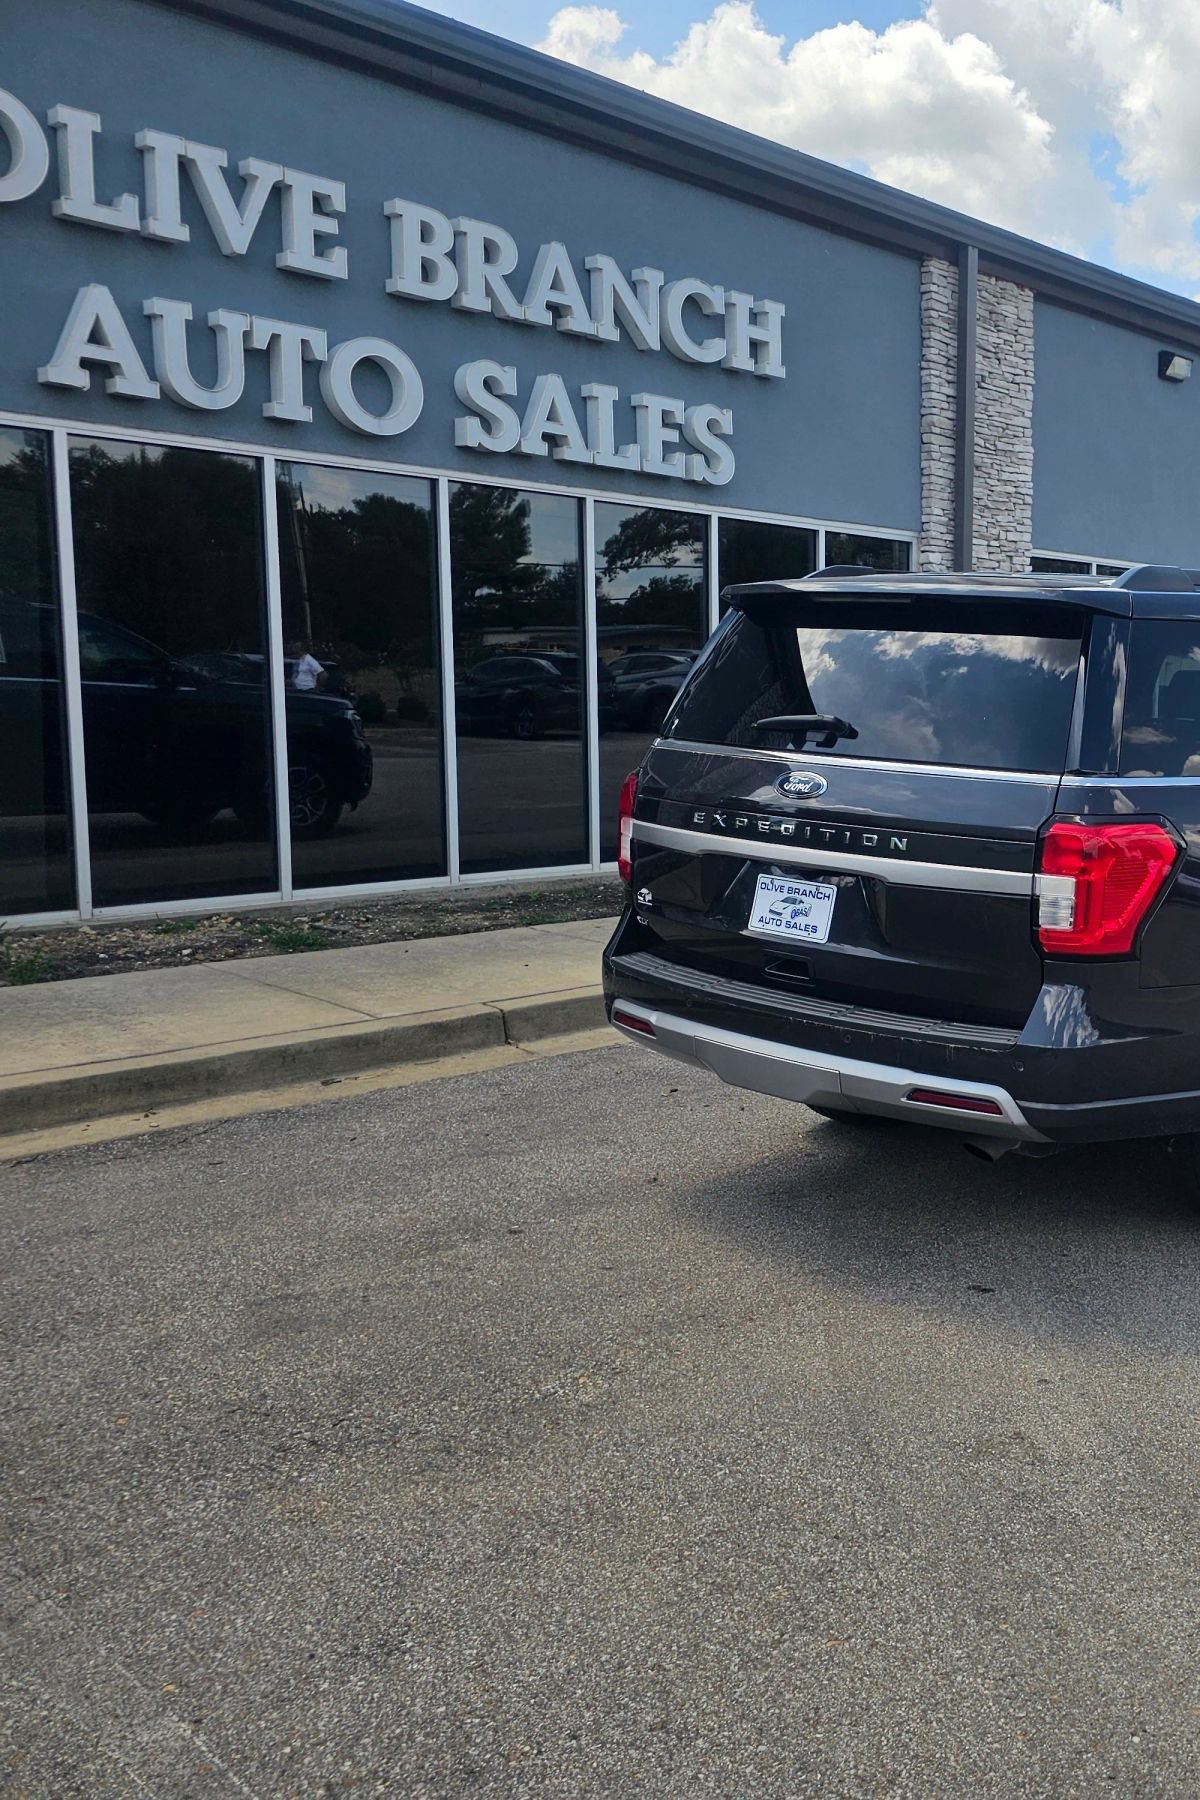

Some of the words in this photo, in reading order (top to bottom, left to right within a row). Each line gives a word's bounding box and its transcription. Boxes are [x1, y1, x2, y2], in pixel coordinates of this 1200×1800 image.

[384, 198, 786, 379] BRANCH
[37, 283, 424, 437] AUTO
[453, 359, 736, 486] SALES
[783, 775, 814, 793] Ford
[693, 811, 908, 850] EXPEDITION
[760, 881, 785, 893] OLIVE
[787, 886, 831, 901] BRANCH
[758, 915, 782, 927] AUTO
[784, 920, 818, 934] SALES
